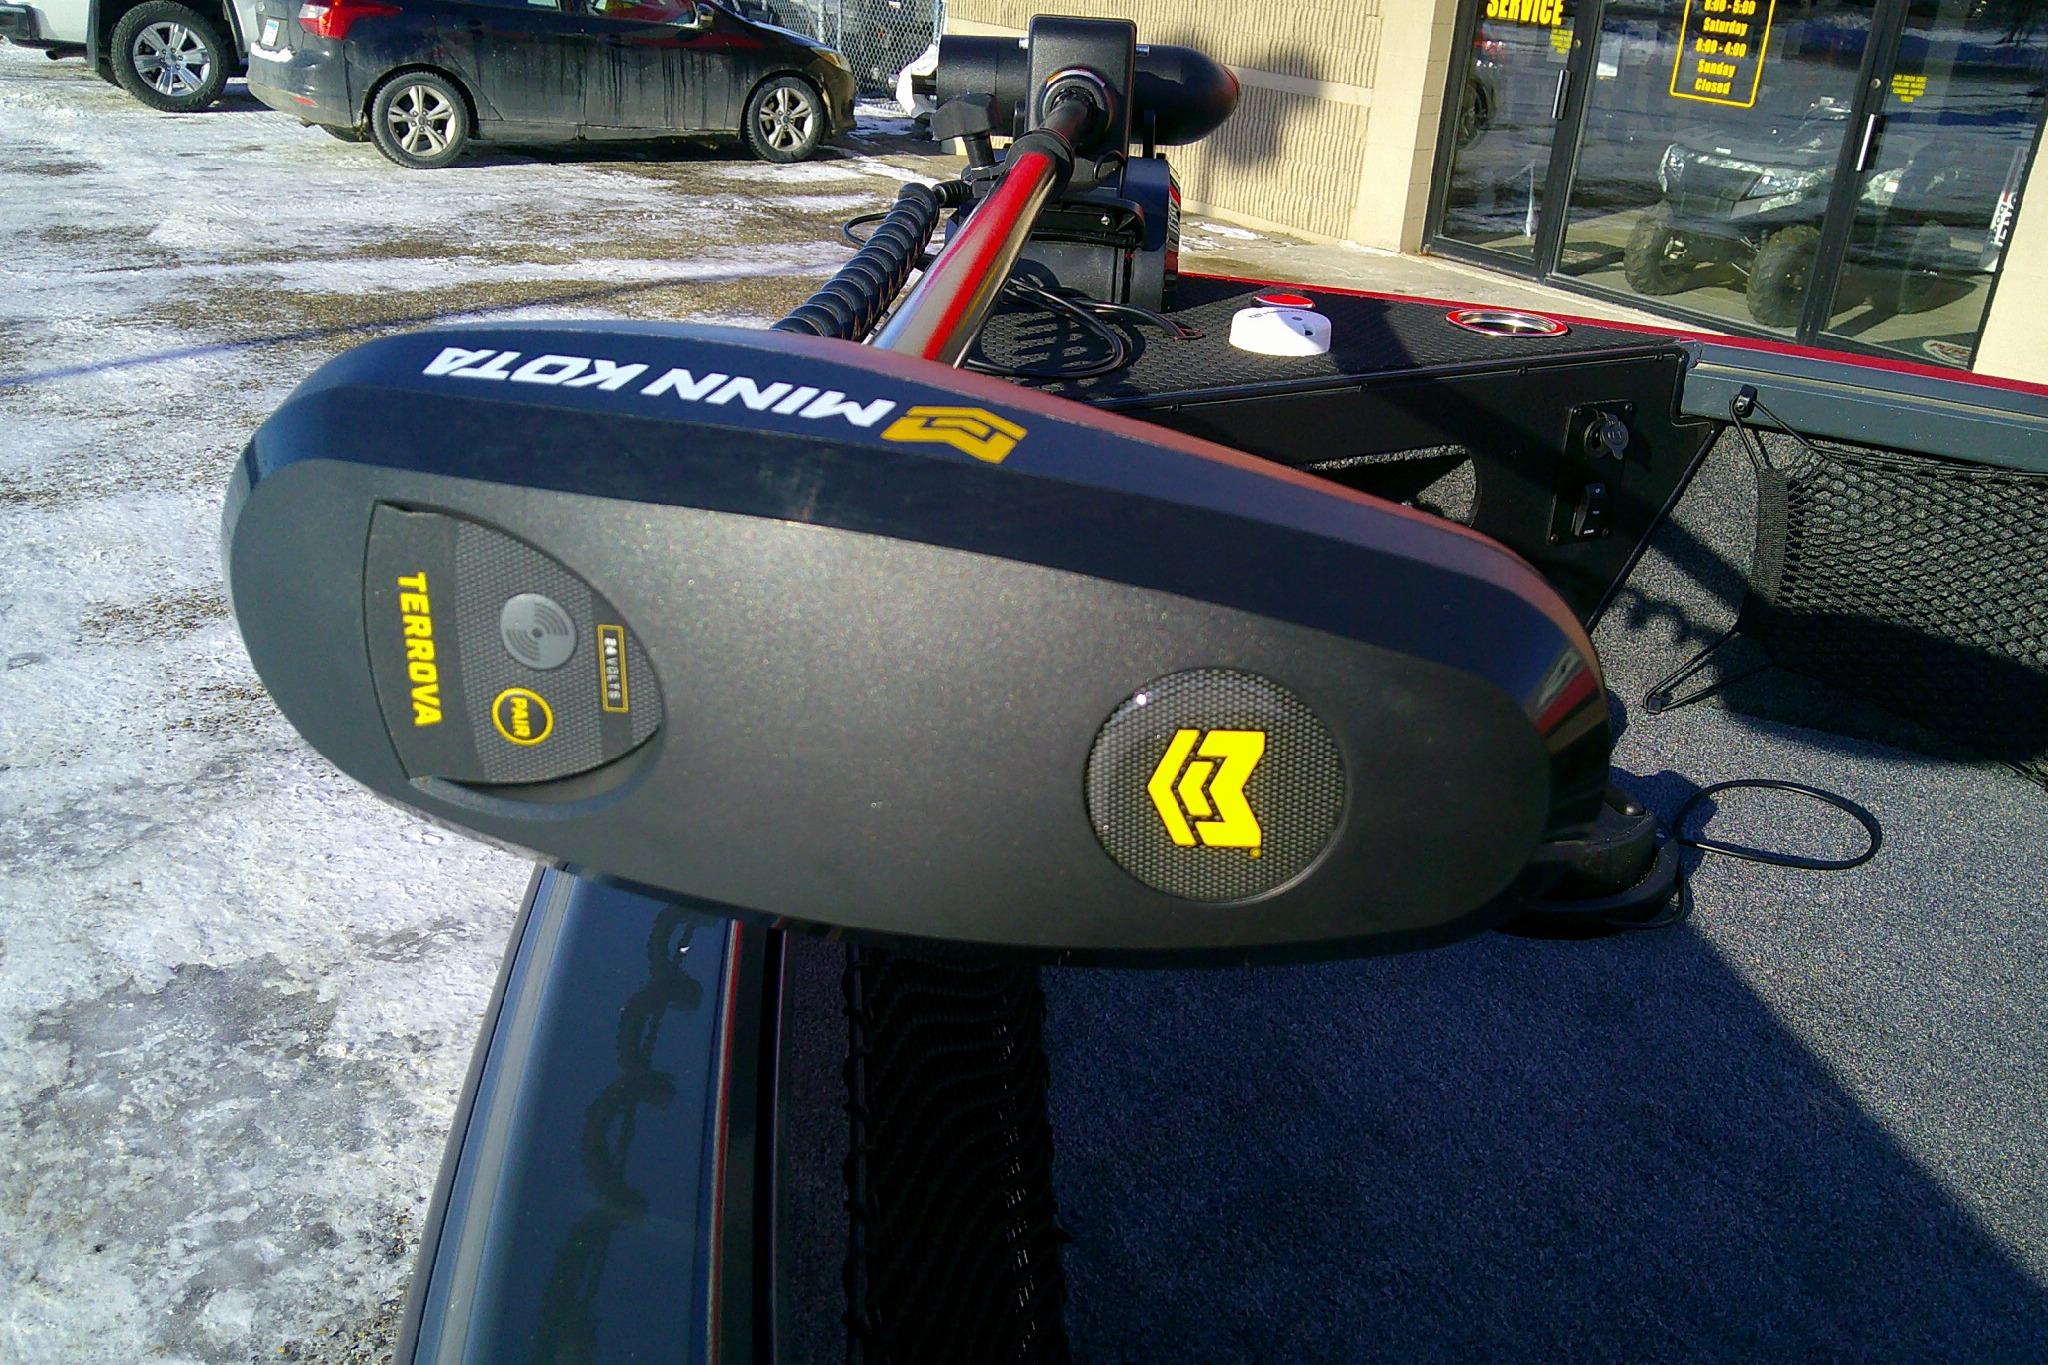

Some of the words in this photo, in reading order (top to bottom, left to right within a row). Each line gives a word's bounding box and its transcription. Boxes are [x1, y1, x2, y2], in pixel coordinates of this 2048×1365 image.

[1486, 0, 1564, 26] SERVICE
[1703, 17, 1748, 36] Saturday
[1695, 38, 1718, 54] 8:00
[1723, 41, 1747, 58] 4:00
[1697, 59, 1736, 78] Sunday
[1694, 78, 1731, 95] Closed
[422, 347, 649, 391] KOTA
[642, 368, 896, 427] MINN
[398, 572, 442, 726] TERROVA
[511, 697, 531, 737] PAIR
